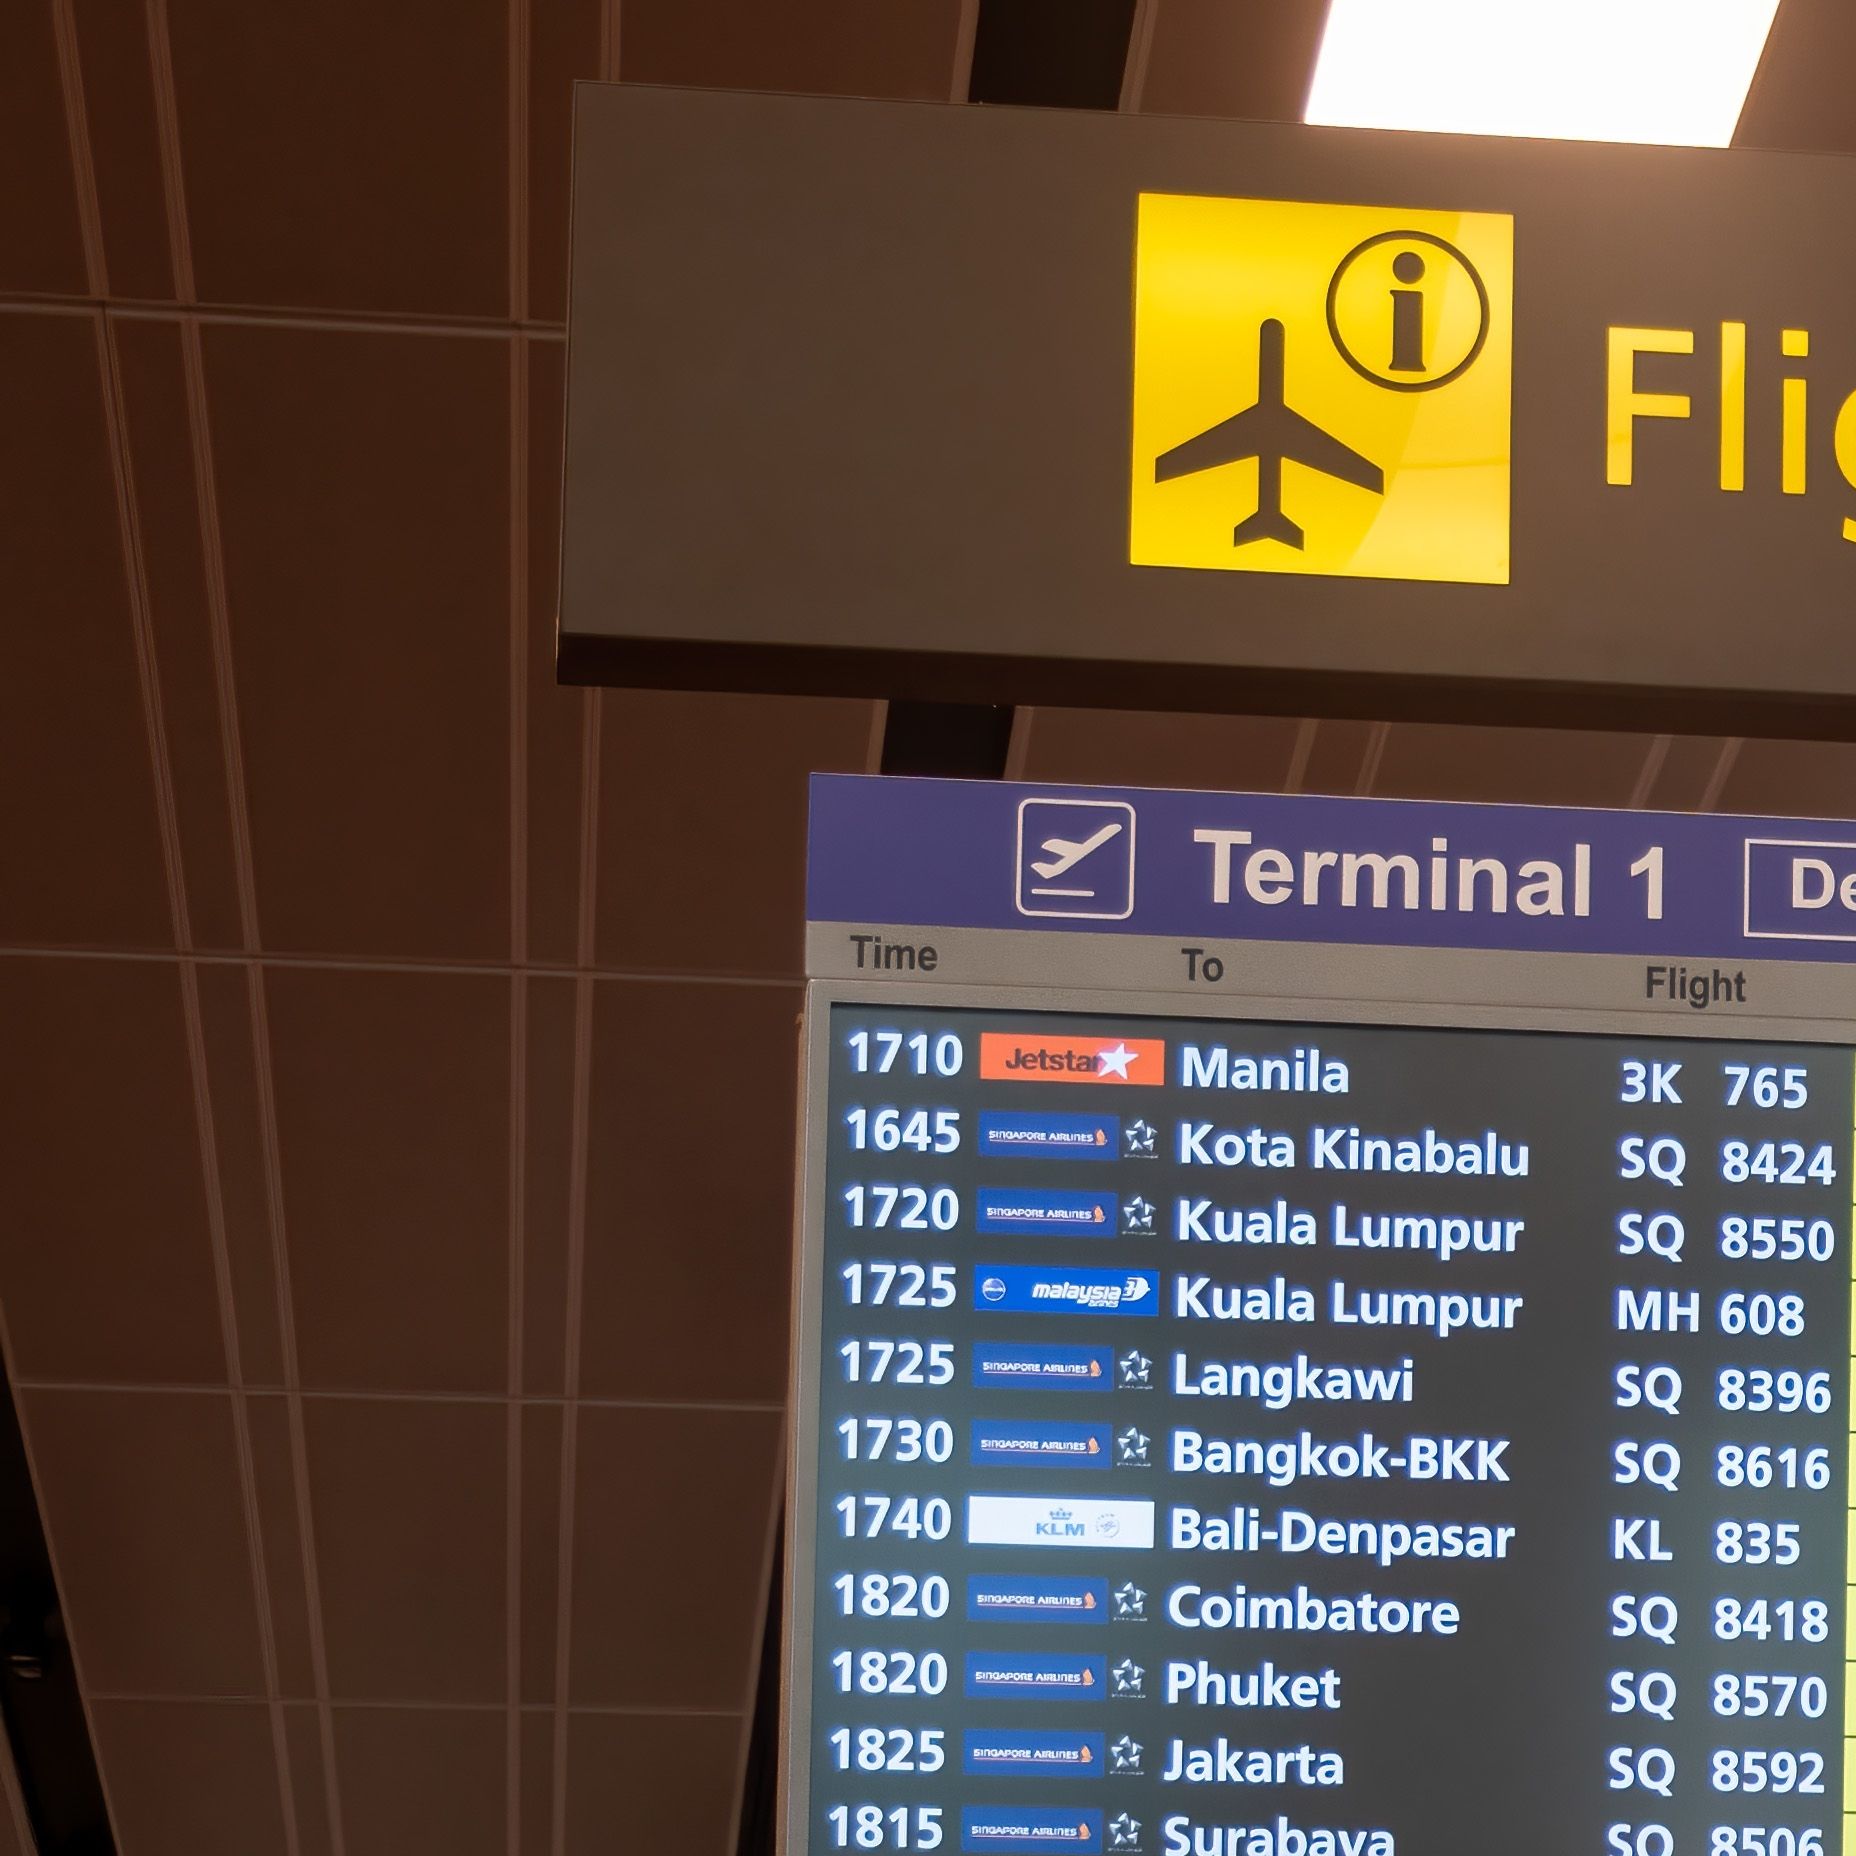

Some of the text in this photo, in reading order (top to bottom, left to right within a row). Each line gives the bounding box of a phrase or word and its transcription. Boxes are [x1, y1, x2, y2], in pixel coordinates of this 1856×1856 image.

[1194, 829, 1590, 916] Terminal
[1631, 847, 1663, 919] 1
[850, 935, 937, 971] Time
[1181, 948, 1223, 982] To
[1647, 966, 1746, 1009] Flight
[849, 1032, 962, 1075] 1710
[1005, 1048, 1100, 1073] Jetstar
[1183, 1047, 1348, 1092] Manila
[1622, 1062, 1682, 1103] 3K
[1725, 1066, 1807, 1108] 765
[848, 1109, 960, 1152] 1645
[988, 1130, 1047, 1142] SINGAPORE
[1048, 1131, 1095, 1143] AIRLINES
[1181, 1123, 1294, 1167] Kota
[1314, 1128, 1528, 1175] Kinabalu
[1621, 1138, 1685, 1186] SQ
[1723, 1142, 1836, 1185] 8424
